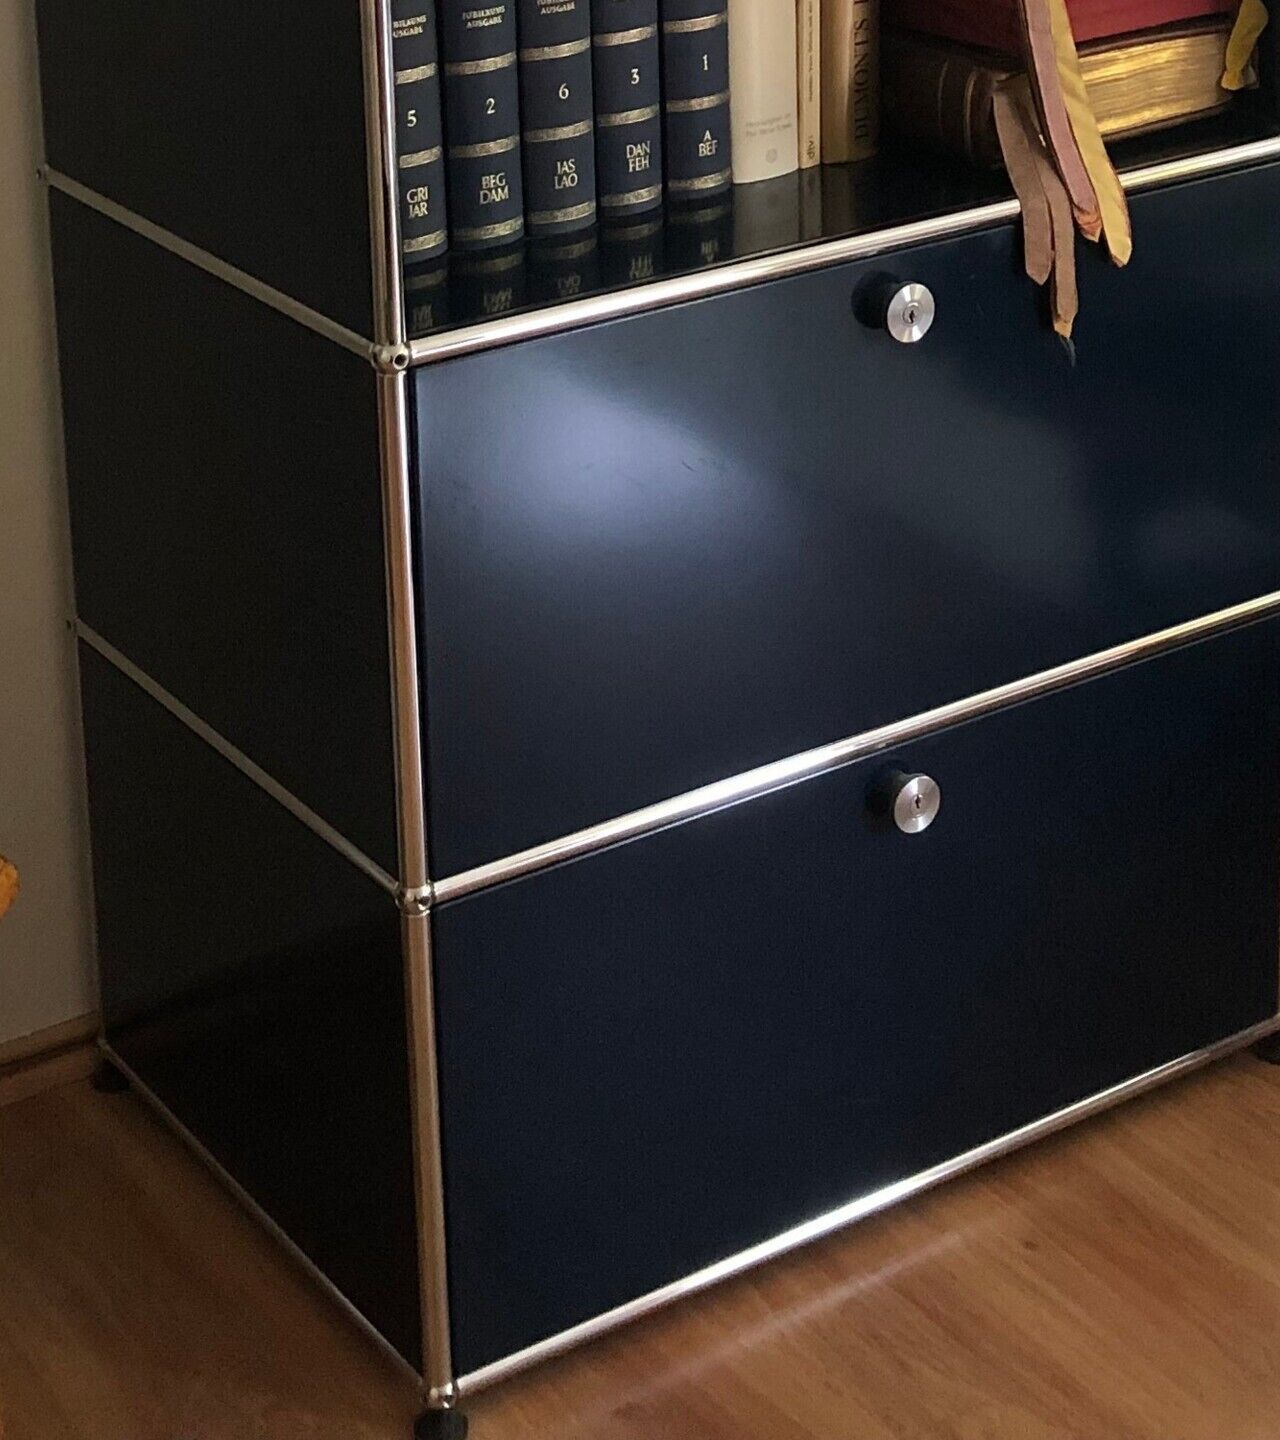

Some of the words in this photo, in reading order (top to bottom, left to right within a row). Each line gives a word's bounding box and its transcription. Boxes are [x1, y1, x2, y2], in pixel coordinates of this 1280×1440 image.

[702, 54, 708, 70] 1
[631, 68, 640, 85] 3
[558, 83, 569, 100] 6
[486, 98, 496, 114] 2
[407, 109, 417, 127] 5
[703, 130, 711, 141] A
[626, 141, 651, 159] DAN
[628, 154, 650, 173] FEH
[481, 172, 506, 189] BEG
[554, 173, 578, 190] LAO
[406, 185, 429, 204] GRI
[480, 185, 509, 205] DAM
